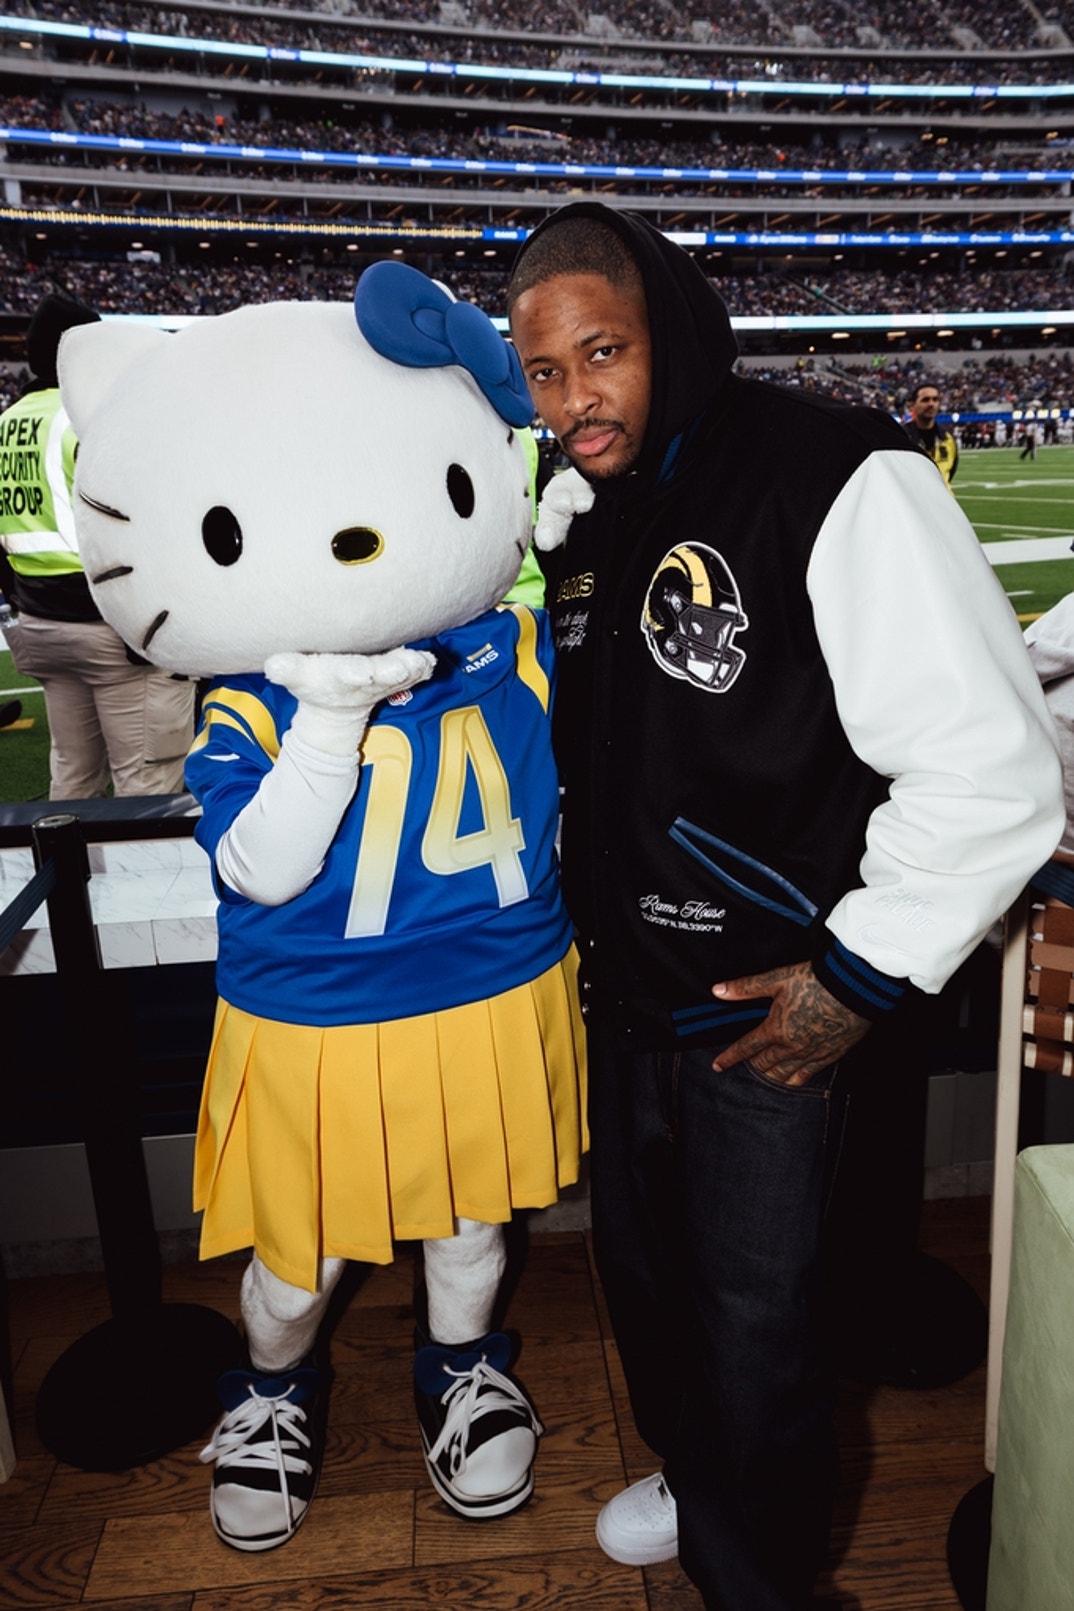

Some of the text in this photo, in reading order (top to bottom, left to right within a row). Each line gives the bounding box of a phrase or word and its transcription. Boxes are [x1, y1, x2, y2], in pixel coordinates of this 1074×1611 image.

[557, 572, 595, 602] AMS
[461, 650, 499, 673] AMS
[344, 705, 529, 939] 14
[639, 894, 678, 916] Rams
[680, 900, 726, 920] House
